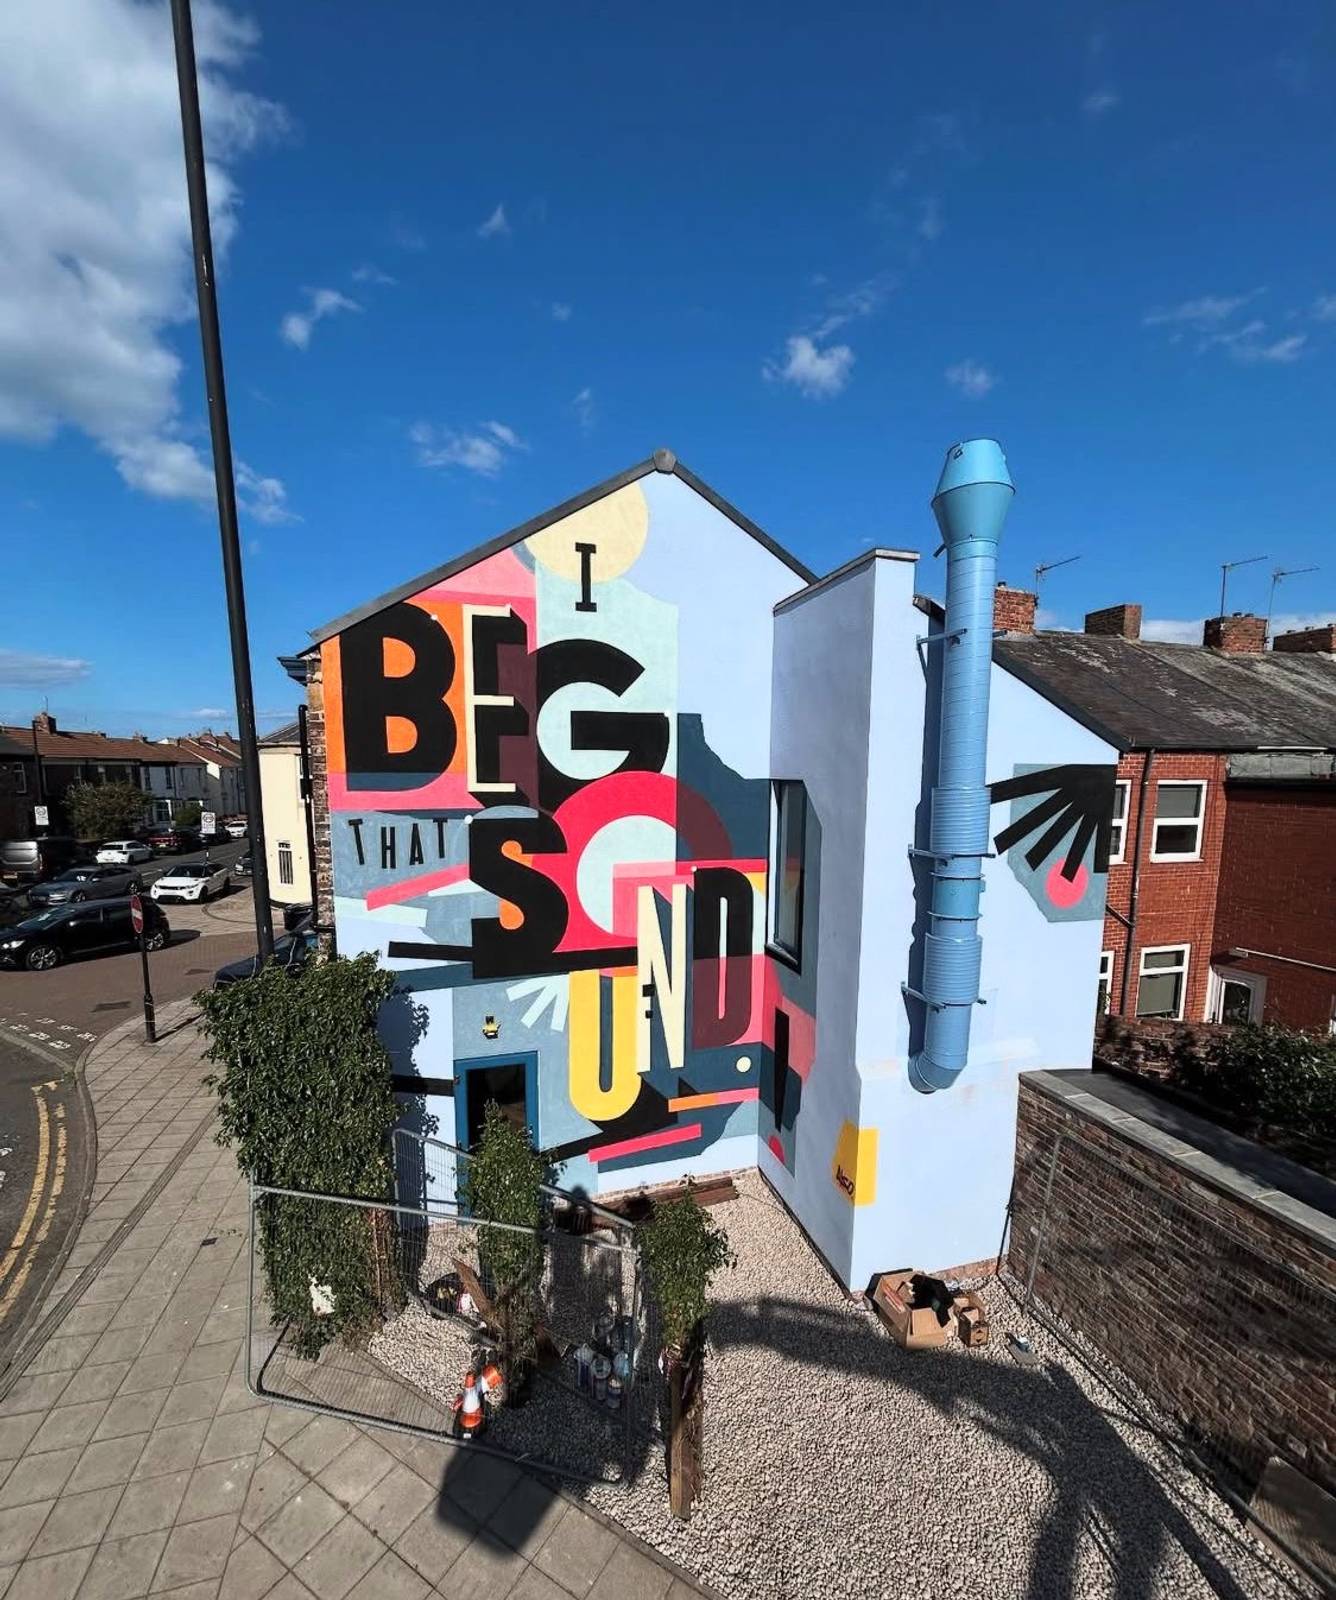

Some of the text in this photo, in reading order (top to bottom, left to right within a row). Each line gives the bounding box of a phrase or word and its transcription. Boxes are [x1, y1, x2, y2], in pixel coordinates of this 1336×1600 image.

[575, 542, 597, 612] I
[339, 602, 669, 808] BEG
[348, 818, 448, 870] THAT
